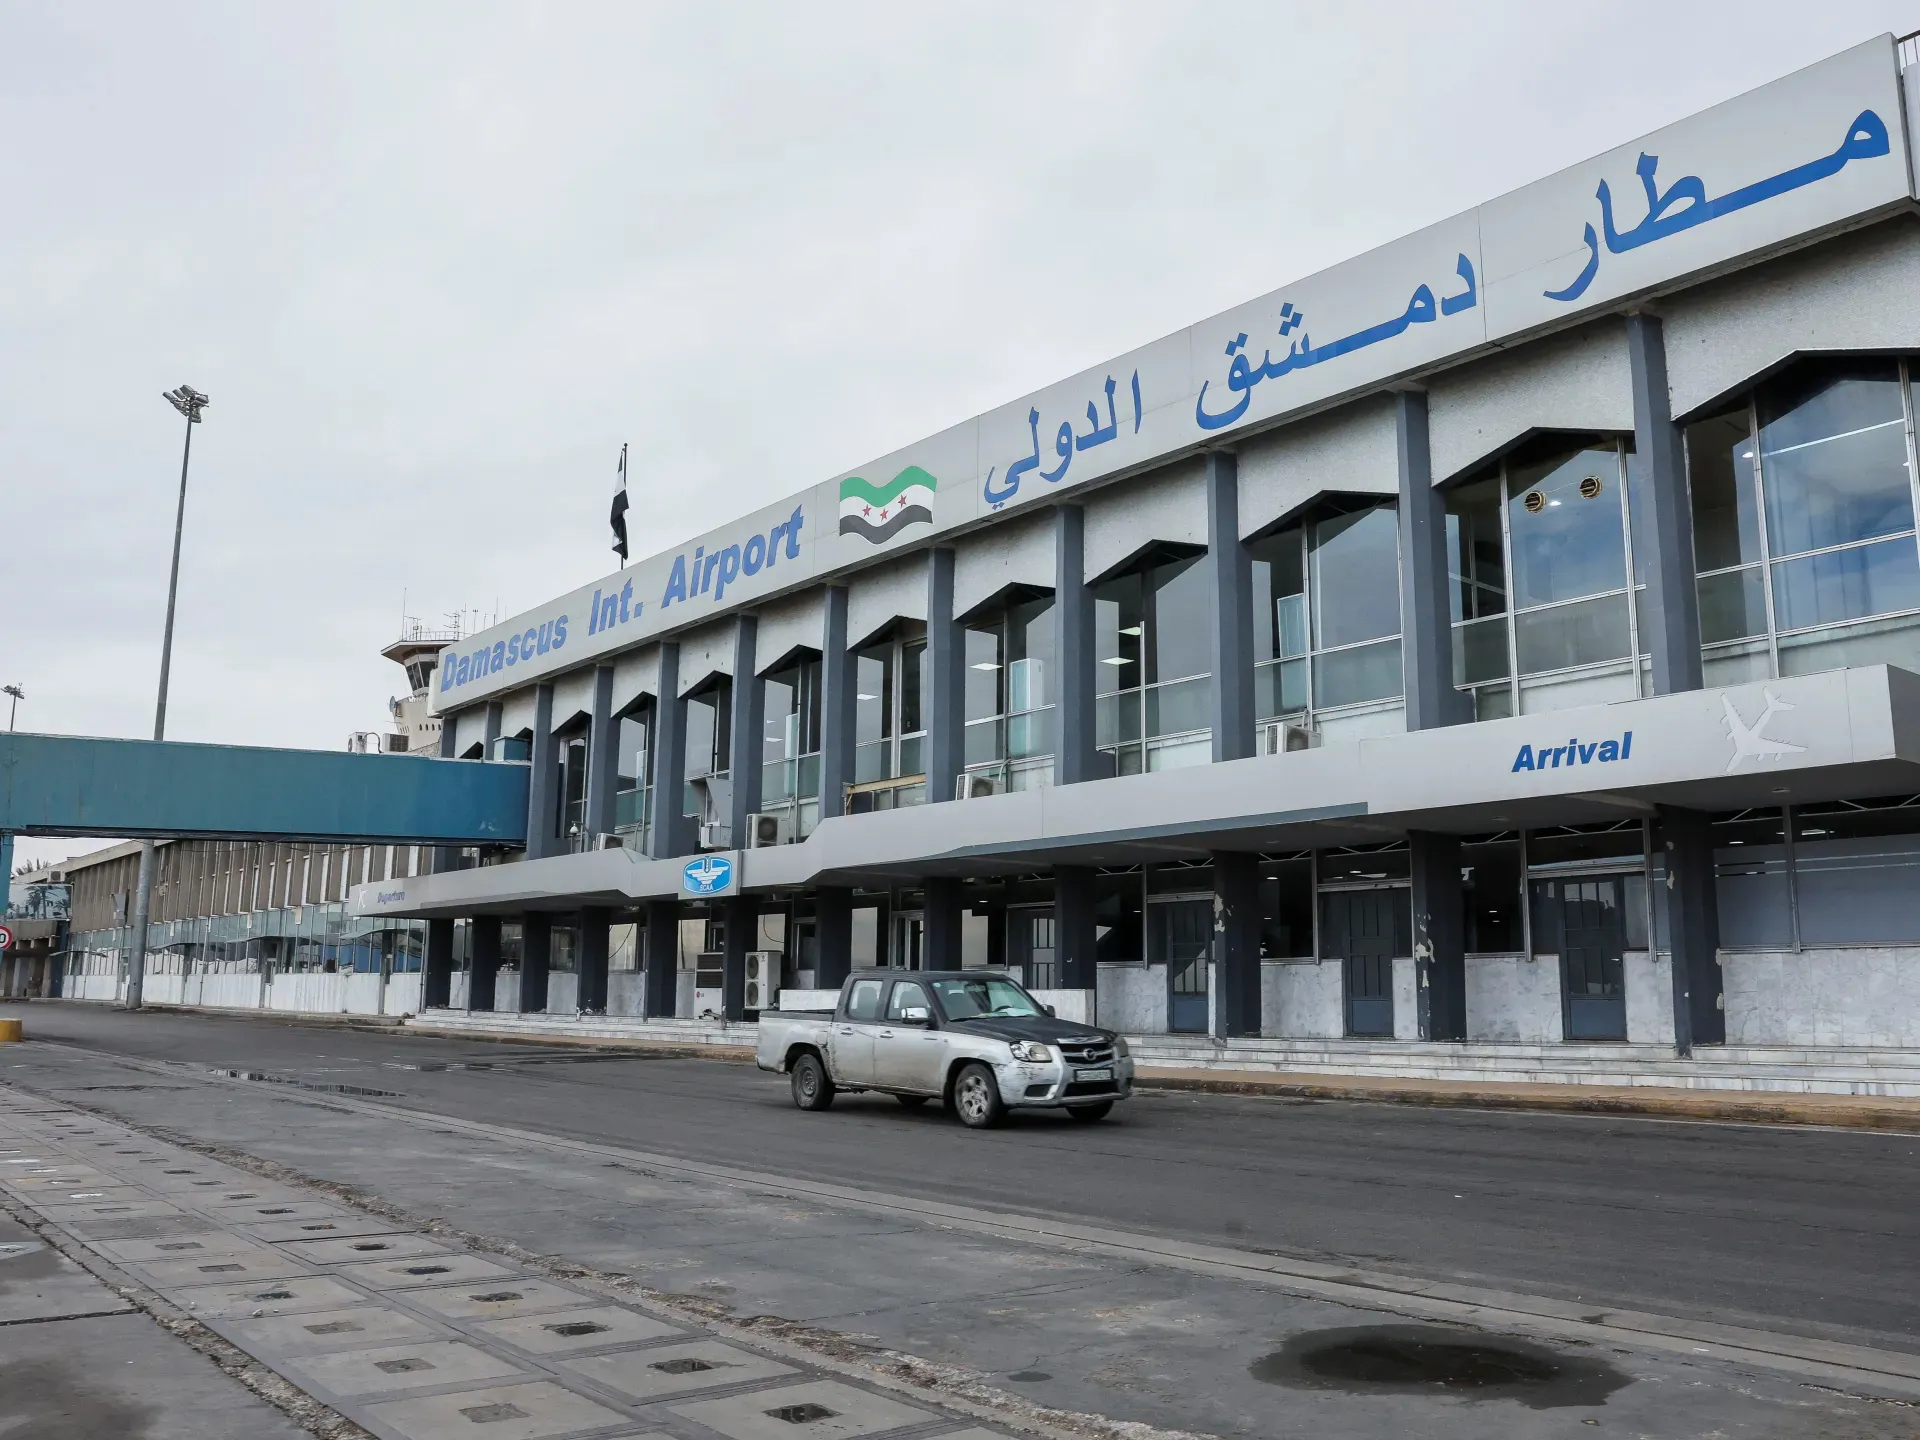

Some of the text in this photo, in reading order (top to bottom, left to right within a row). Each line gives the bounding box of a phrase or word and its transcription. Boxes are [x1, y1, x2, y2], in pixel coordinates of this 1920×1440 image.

[983, 108, 1892, 512] مطار دمشق الدولي
[440, 505, 805, 693] Damascus Int. Airport
[1511, 731, 1633, 773] Arrival
[699, 884, 714, 892] SCAA
